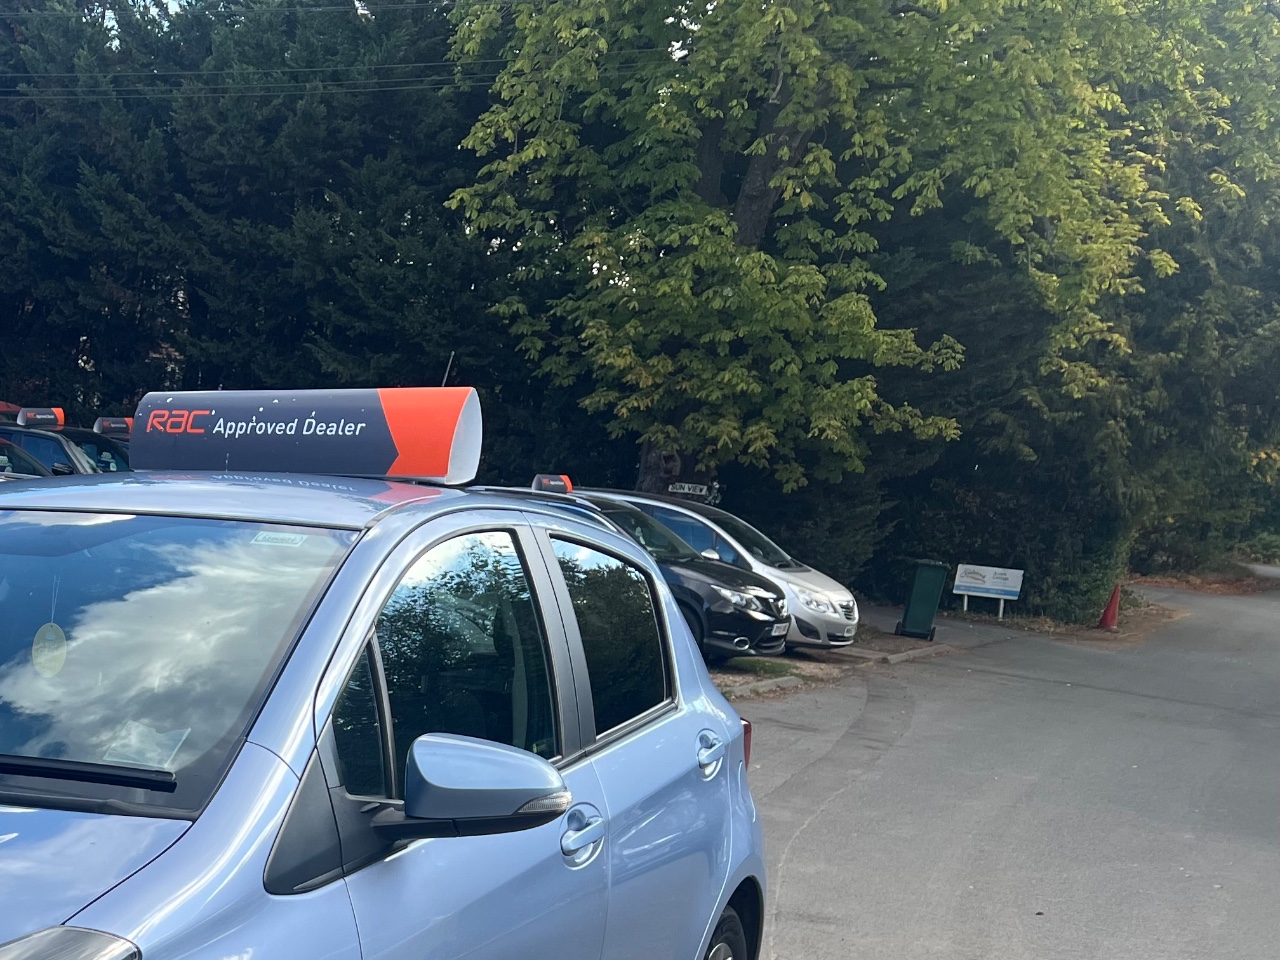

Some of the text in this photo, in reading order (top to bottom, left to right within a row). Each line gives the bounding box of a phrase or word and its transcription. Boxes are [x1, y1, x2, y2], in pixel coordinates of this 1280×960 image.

[146, 409, 367, 439] RAC Approved Dealer
[670, 483, 686, 491] SUN
